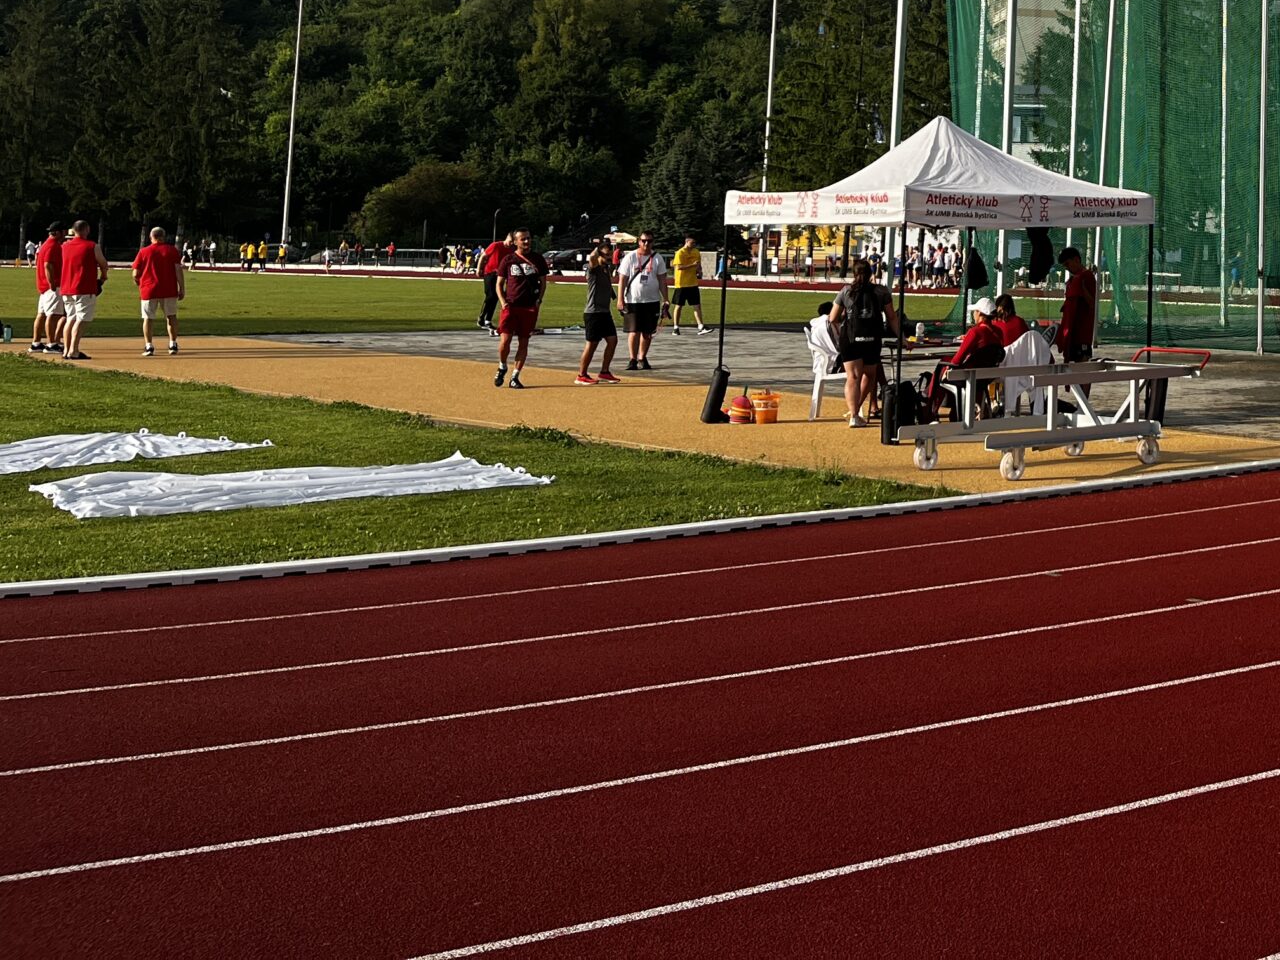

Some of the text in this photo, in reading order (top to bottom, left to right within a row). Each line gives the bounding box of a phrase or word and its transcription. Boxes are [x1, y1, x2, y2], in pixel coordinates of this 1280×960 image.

[767, 194, 783, 205] klub
[926, 193, 998, 208] Atletický klub
[1074, 196, 1138, 209] Atletický klub
[935, 209, 951, 217] UMB
[951, 210, 973, 218] Banská
[974, 211, 998, 219] Bystrica
[1081, 210, 1095, 218] UMB
[1096, 210, 1116, 218] Banská
[1117, 209, 1138, 219] Bystrica
